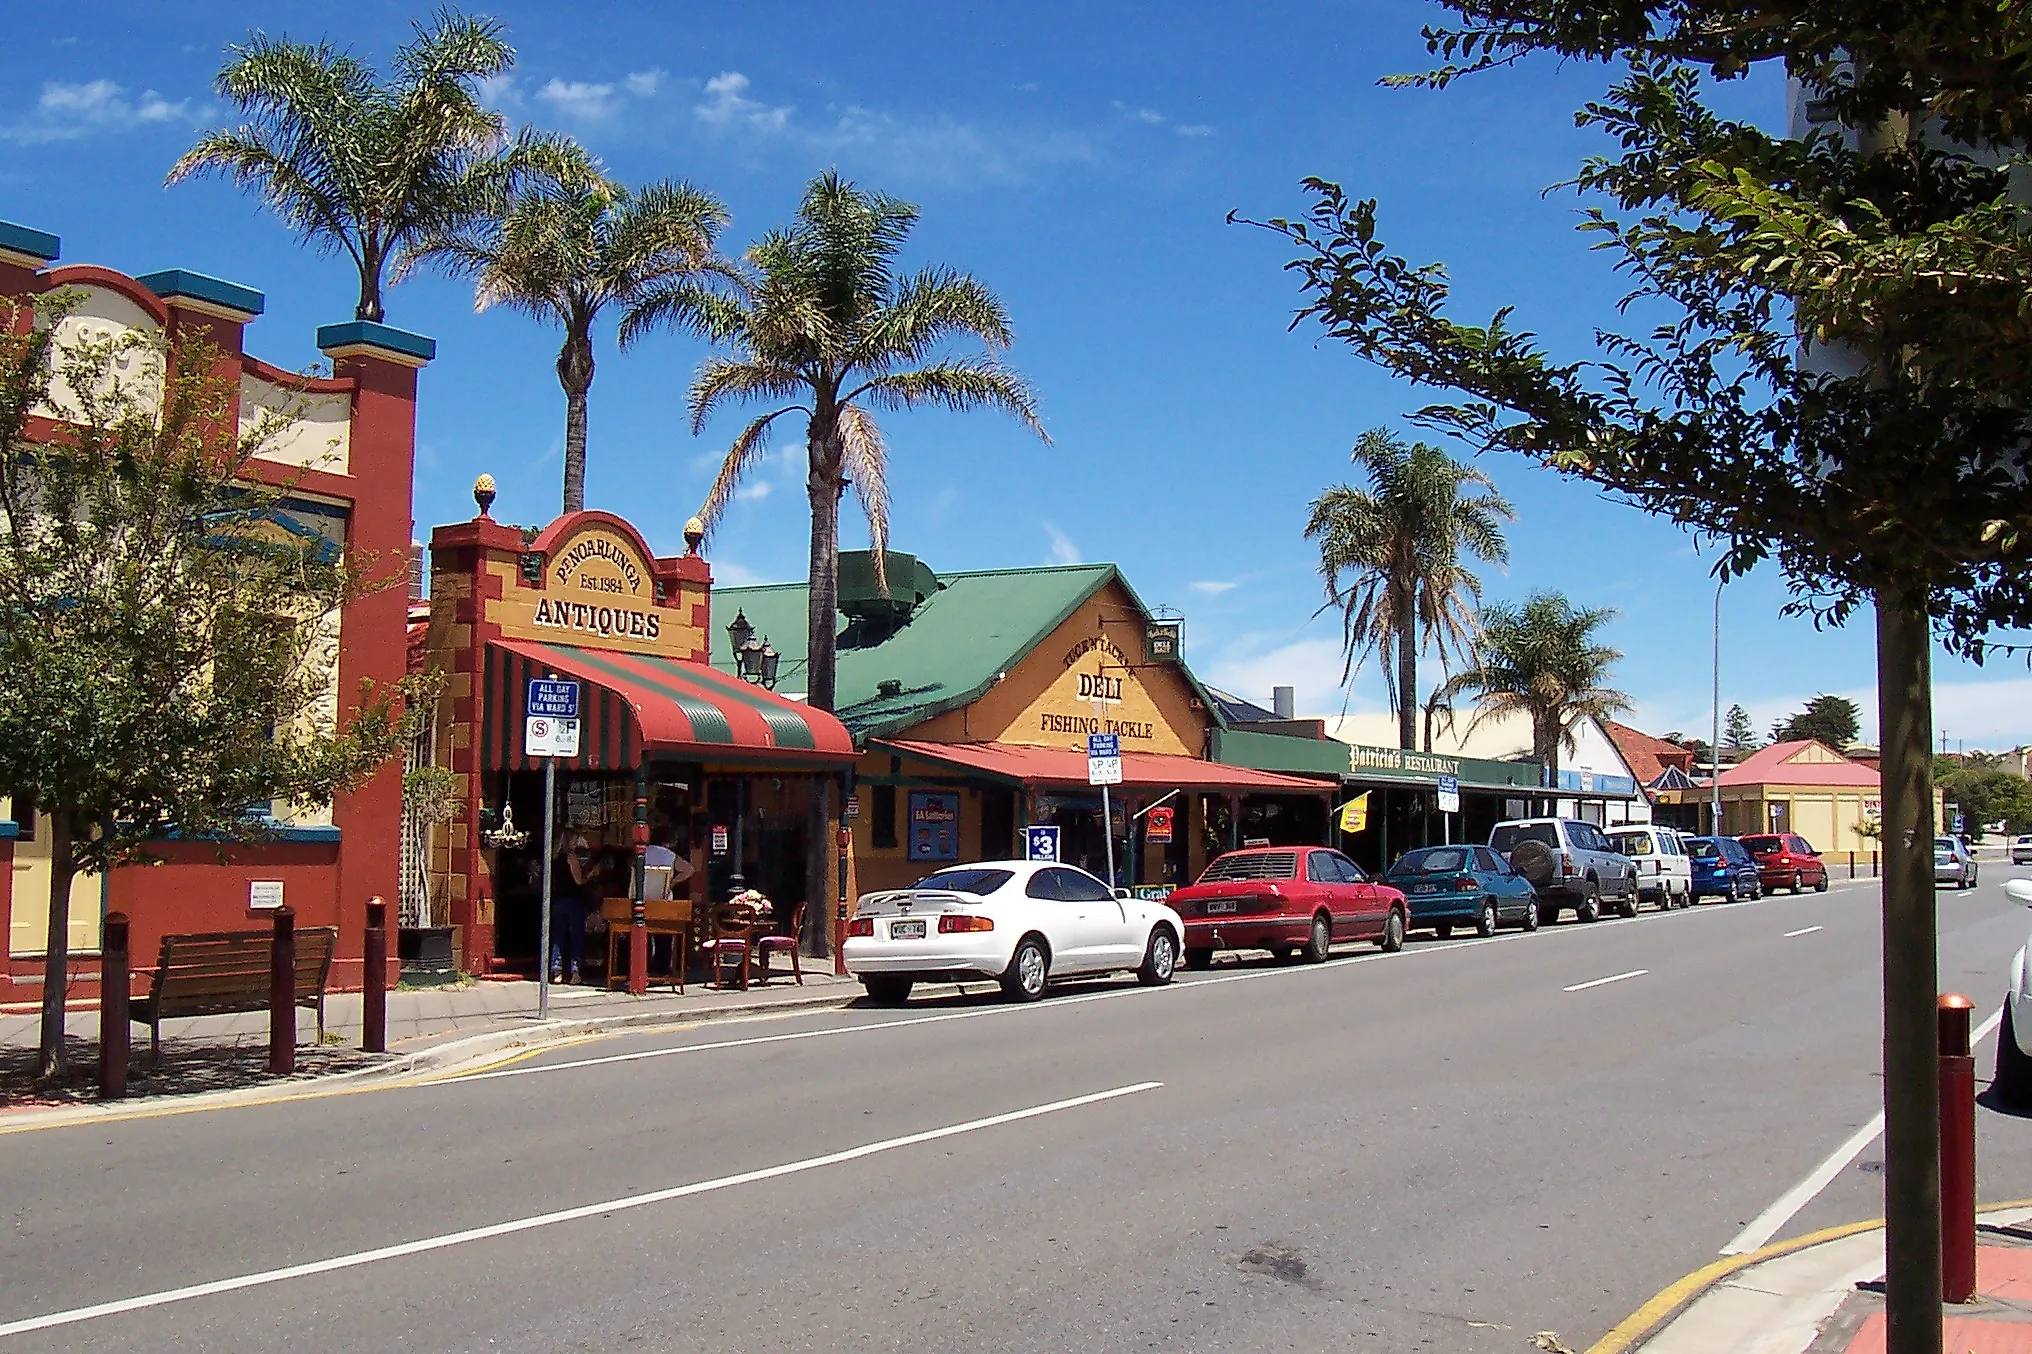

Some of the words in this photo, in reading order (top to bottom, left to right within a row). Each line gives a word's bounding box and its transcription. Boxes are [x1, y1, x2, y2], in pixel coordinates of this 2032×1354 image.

[534, 597, 660, 640] ANTIQUES
[538, 693, 570, 703] PARKING
[539, 684, 554, 693] ALL
[556, 685, 571, 693] DAY
[1077, 673, 1123, 703] DELI
[532, 702, 544, 711] VIA
[1040, 713, 1099, 734] FISHING
[1105, 719, 1153, 739] TACKLE
[1349, 744, 1402, 772] Patricia's
[1404, 755, 1460, 774] RESTAURANT
[1032, 835, 1053, 855] $3
